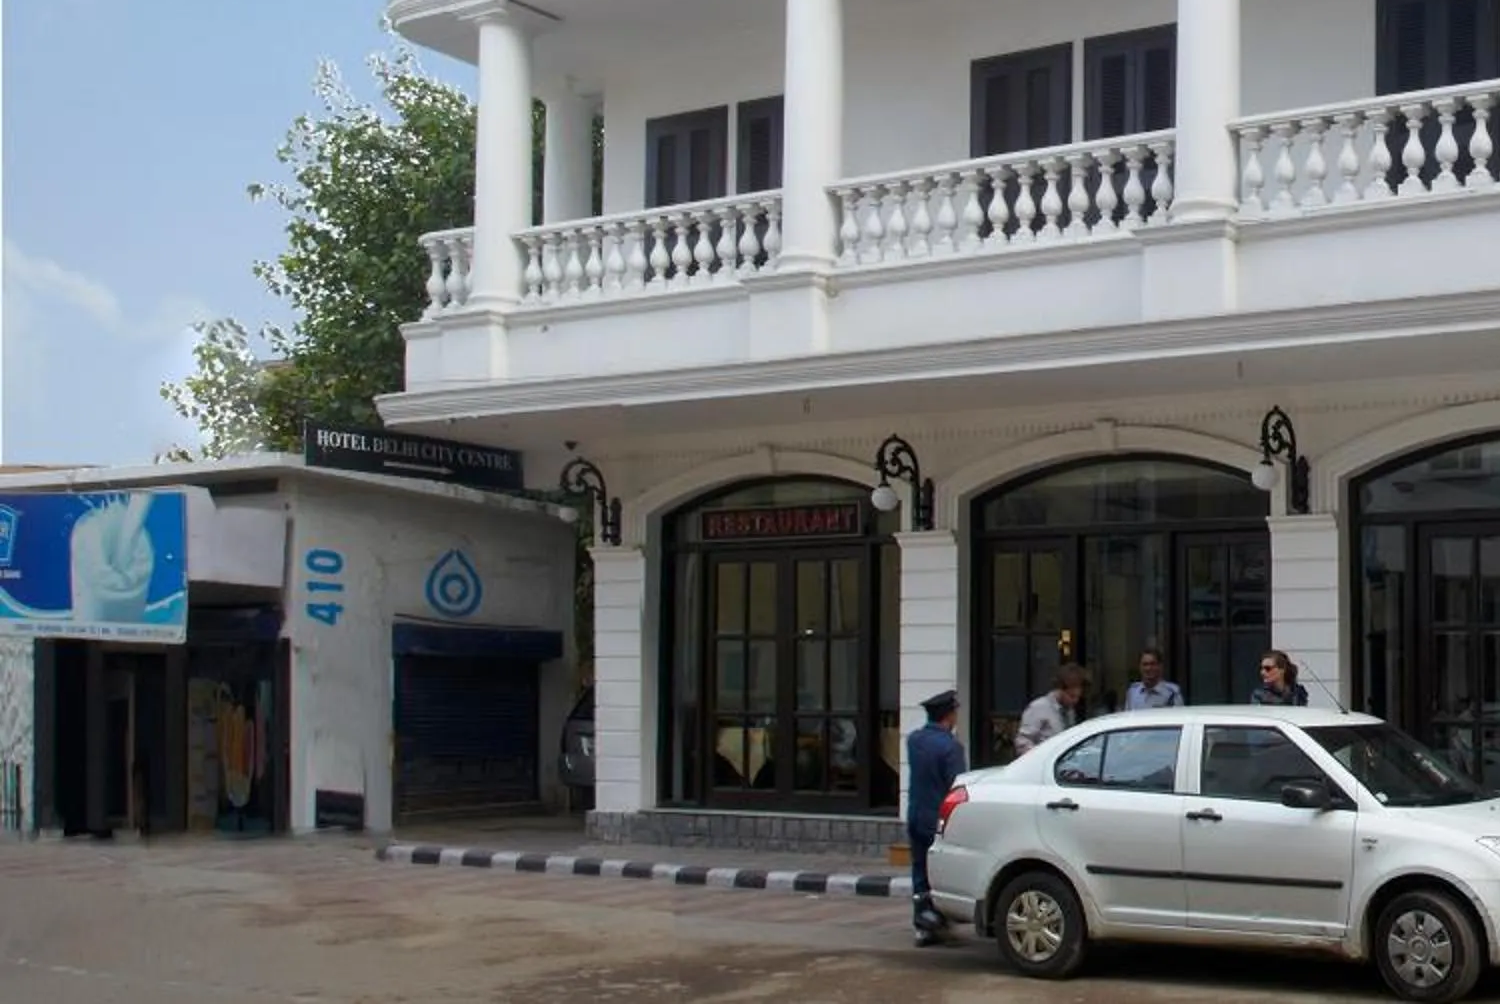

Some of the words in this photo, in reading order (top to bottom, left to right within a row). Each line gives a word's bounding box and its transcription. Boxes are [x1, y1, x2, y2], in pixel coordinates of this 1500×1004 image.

[317, 429, 370, 451] HOTEL
[373, 436, 418, 458] DELHI
[421, 443, 455, 463] CITY
[708, 507, 855, 537] RESTAURANT
[306, 549, 344, 626] 410
